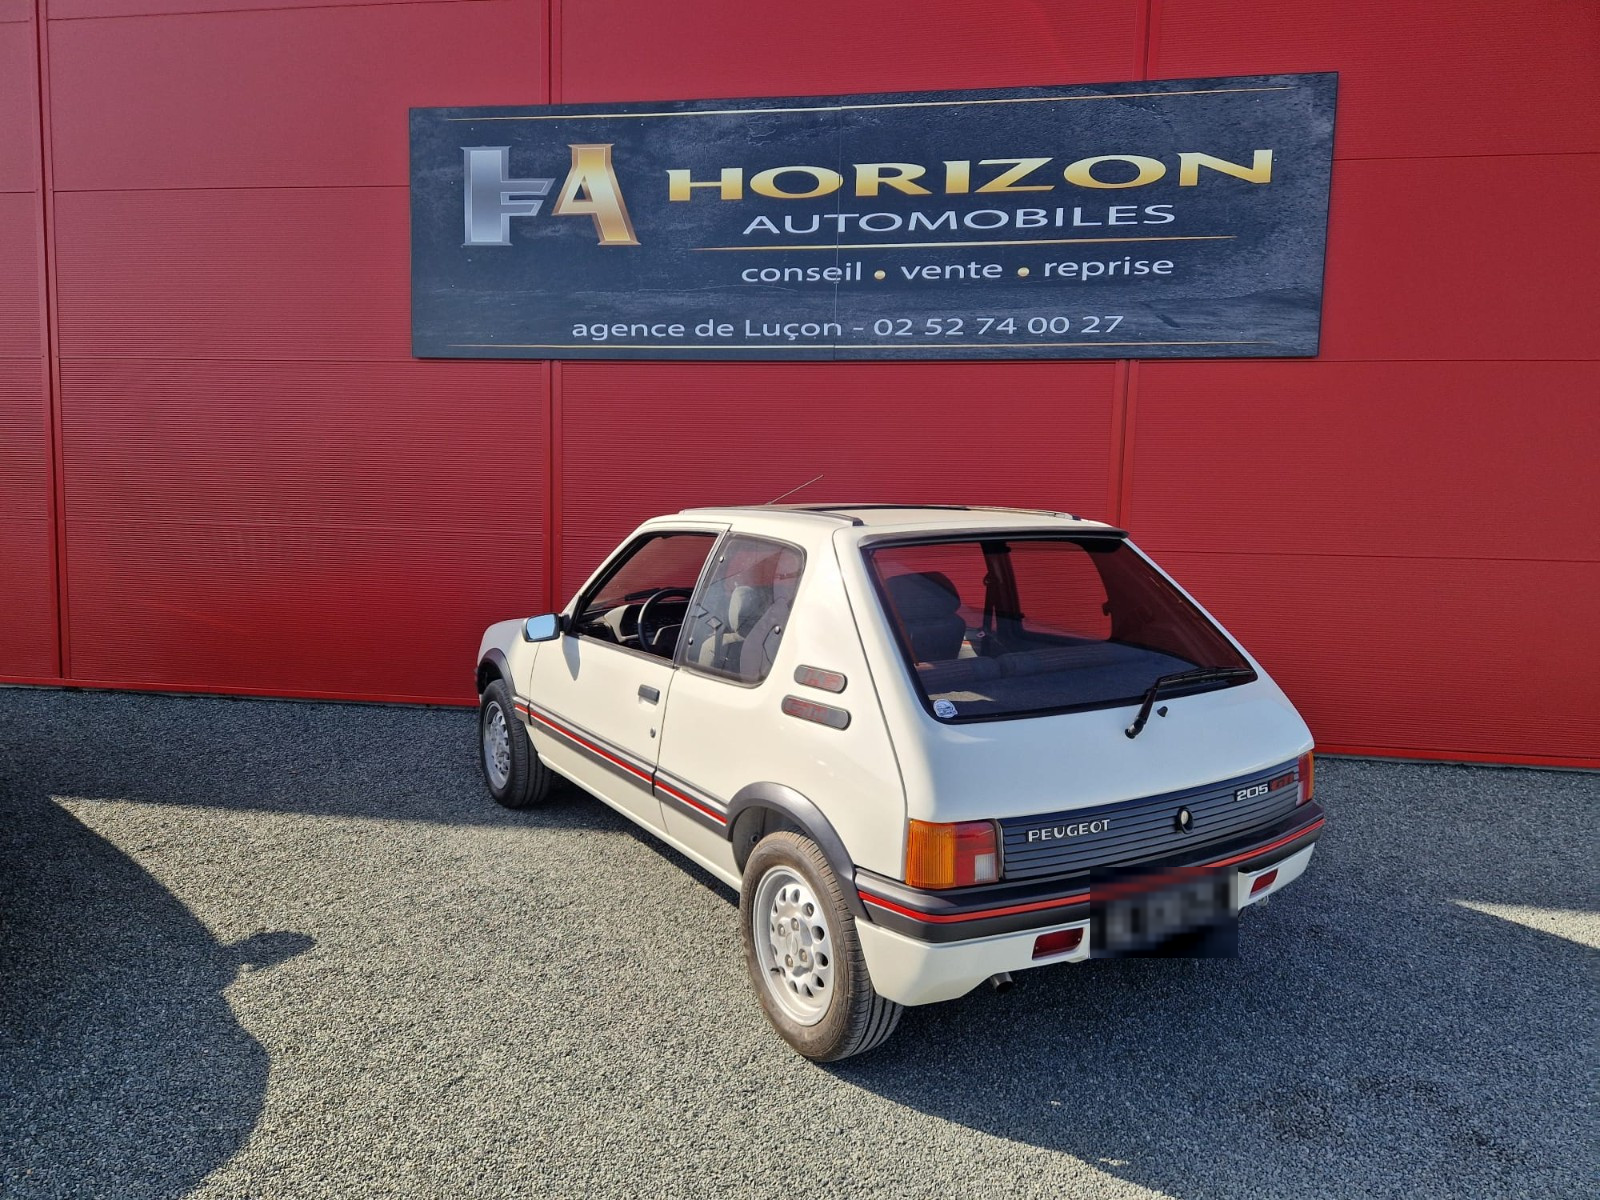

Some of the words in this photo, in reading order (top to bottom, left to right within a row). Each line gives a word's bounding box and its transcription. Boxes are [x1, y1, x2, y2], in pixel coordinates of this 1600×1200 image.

[666, 149, 1274, 202] HORIZON
[742, 204, 1176, 235] AUTOMOBILES
[741, 261, 863, 283] conseil
[900, 260, 1003, 279] vente
[1043, 256, 1175, 281] reprise
[572, 321, 685, 341] agence
[694, 319, 735, 337] de
[745, 319, 842, 341] Luçon
[873, 319, 914, 336] 02
[925, 318, 965, 335] 52
[976, 318, 1018, 335] 74
[1027, 316, 1070, 333] 00
[1081, 315, 1124, 332] 27
[1236, 783, 1269, 801] 205
[1028, 819, 1111, 842] PEUGEOT
